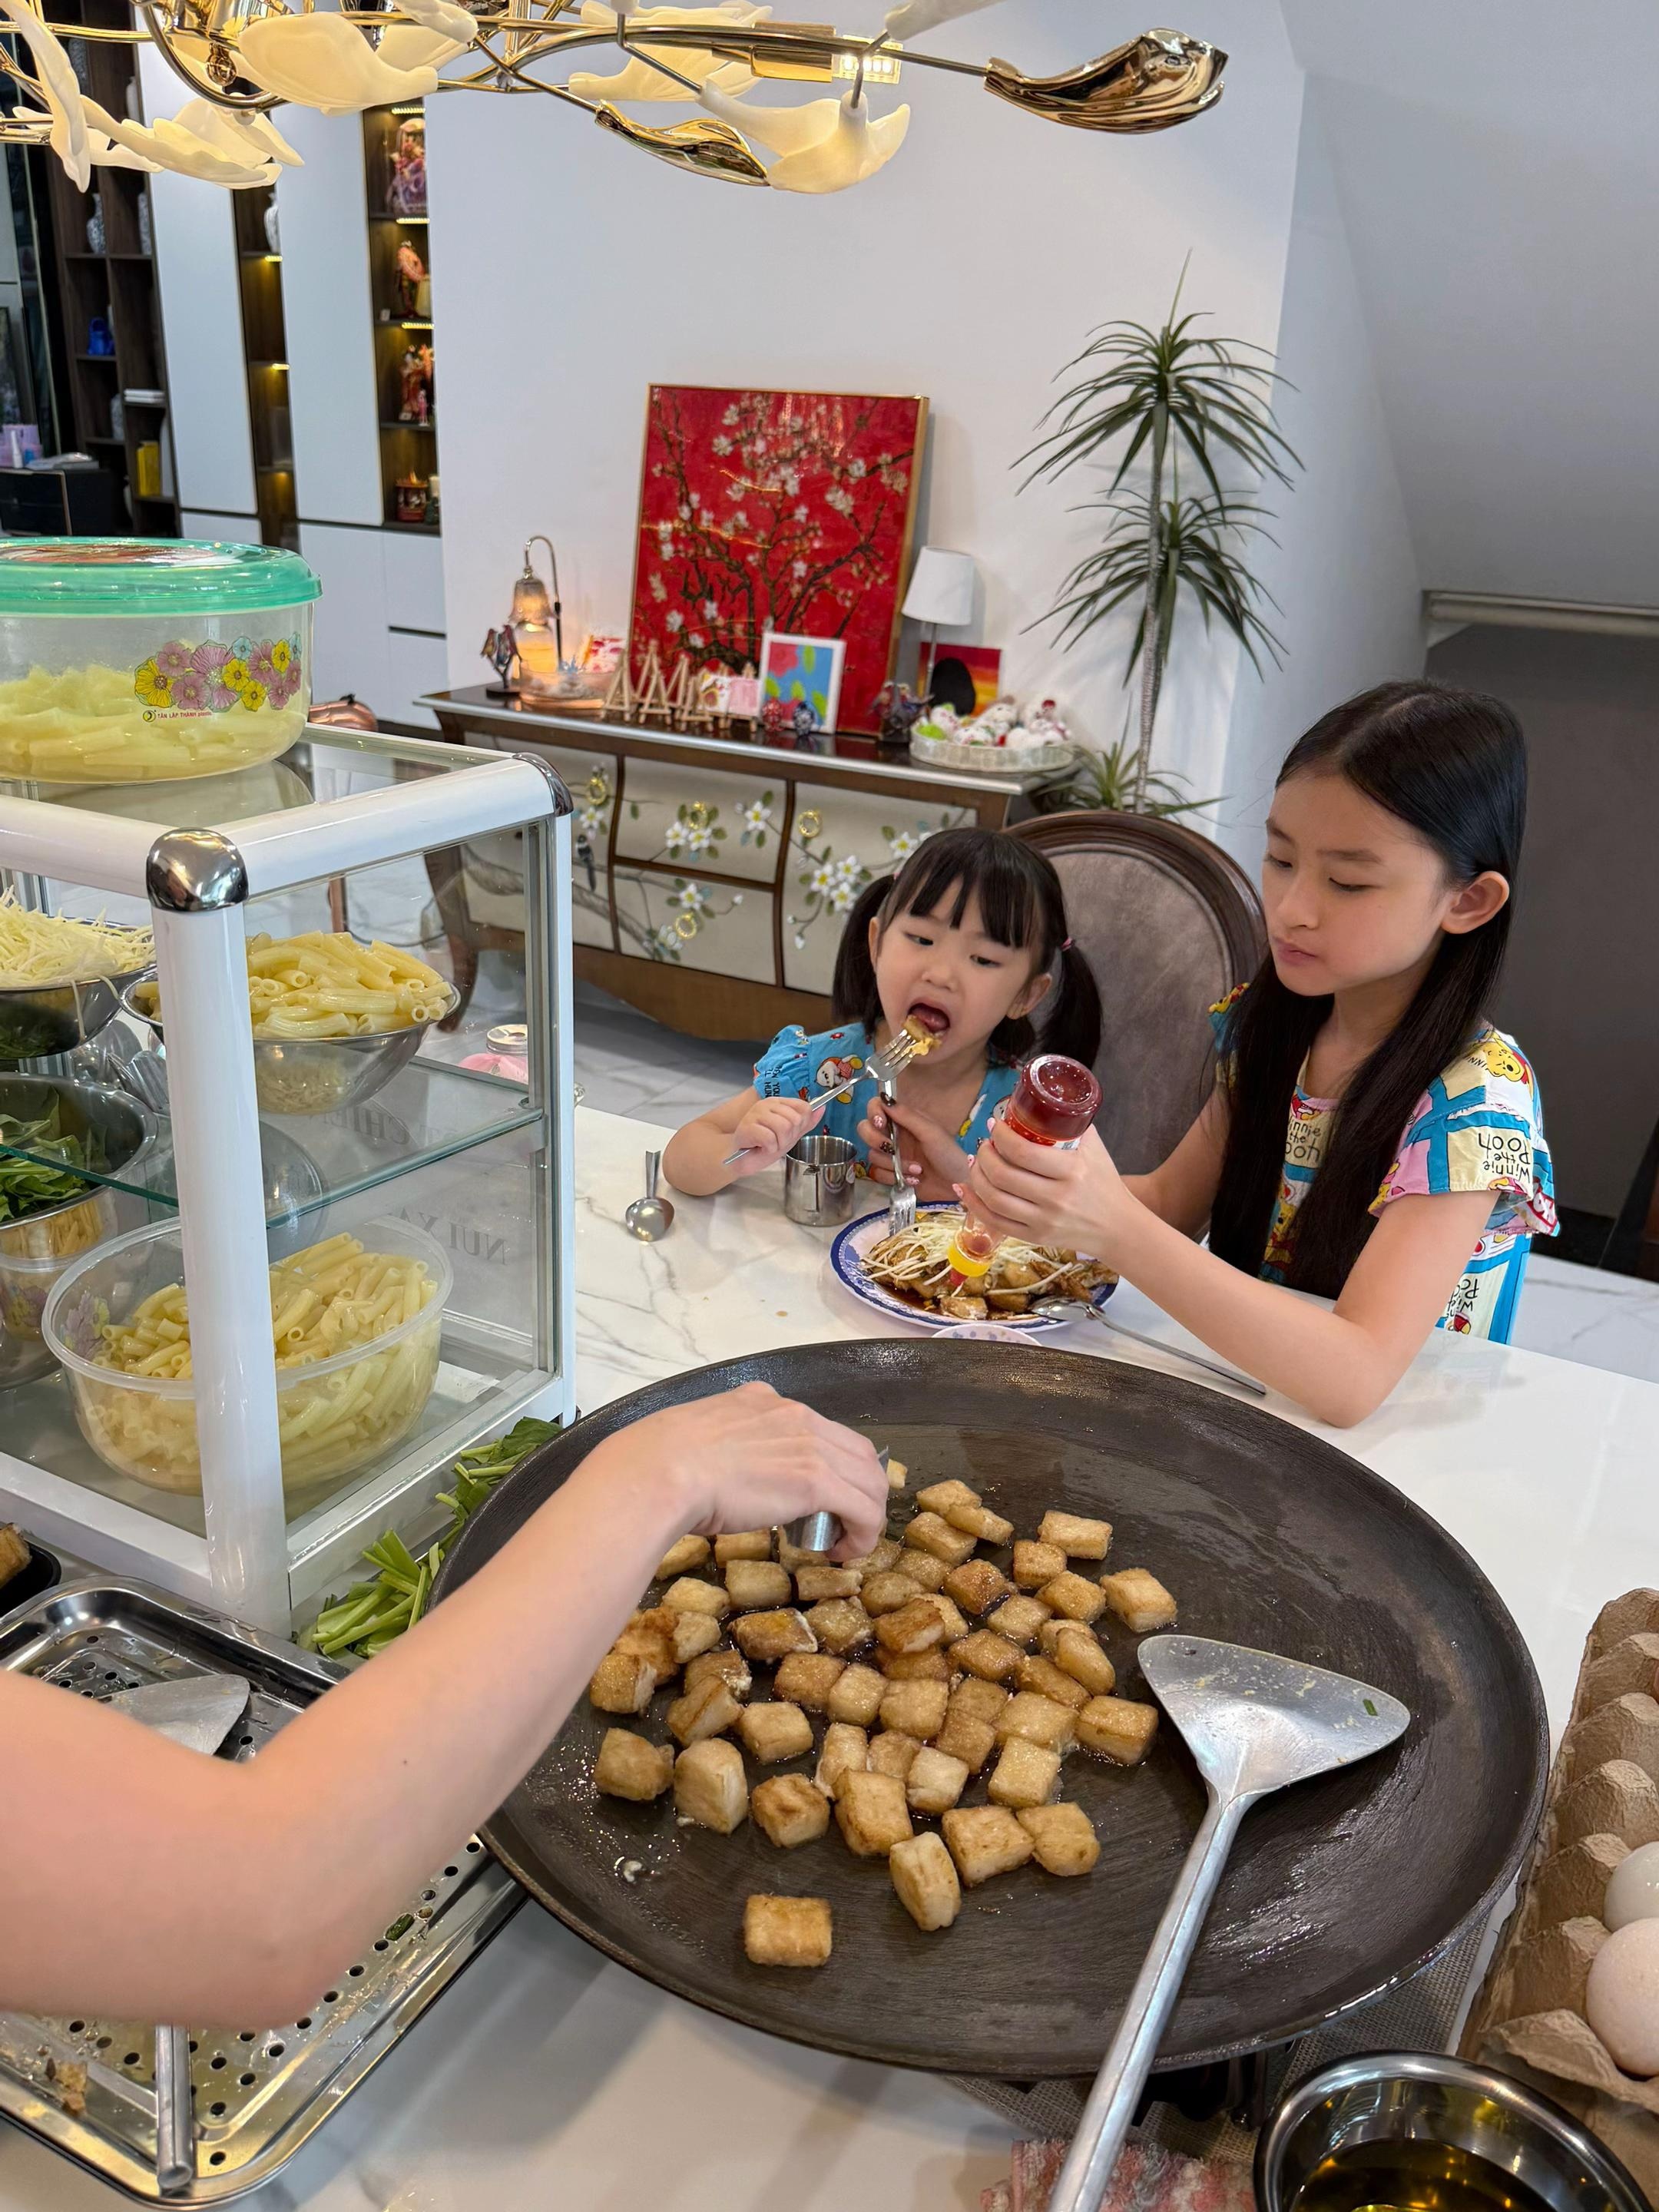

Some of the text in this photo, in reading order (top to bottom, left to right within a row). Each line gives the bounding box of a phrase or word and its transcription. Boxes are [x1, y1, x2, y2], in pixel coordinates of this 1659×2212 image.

[1289, 1116, 1321, 1137] innie
[1285, 1137, 1320, 1163] ooh
[1478, 1133, 1531, 1165] Pooh
[1493, 1151, 1516, 1164] the
[1482, 1161, 1531, 1184] Winnie
